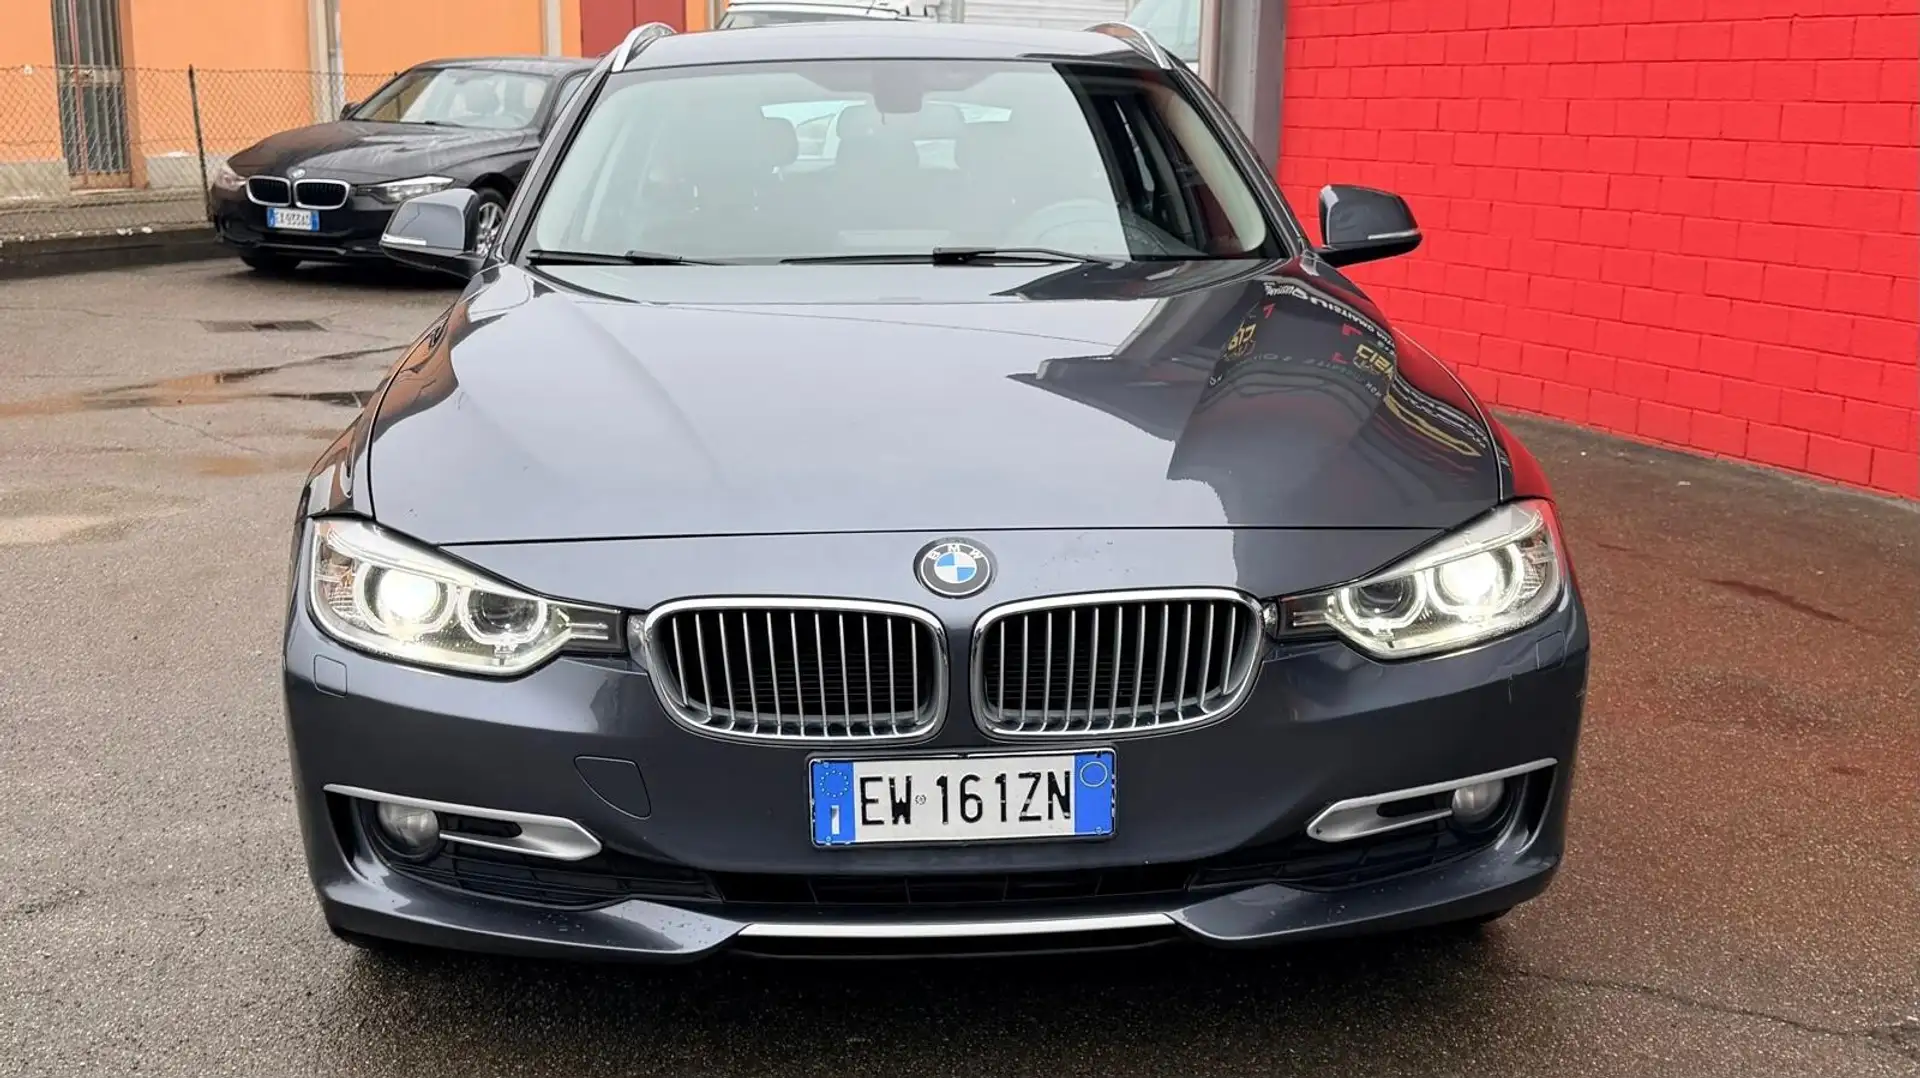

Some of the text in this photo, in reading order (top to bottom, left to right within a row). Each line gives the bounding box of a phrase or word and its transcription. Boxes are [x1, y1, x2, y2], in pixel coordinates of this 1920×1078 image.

[926, 543, 985, 561] BMW
[859, 770, 1072, 826] EW 161ZN
